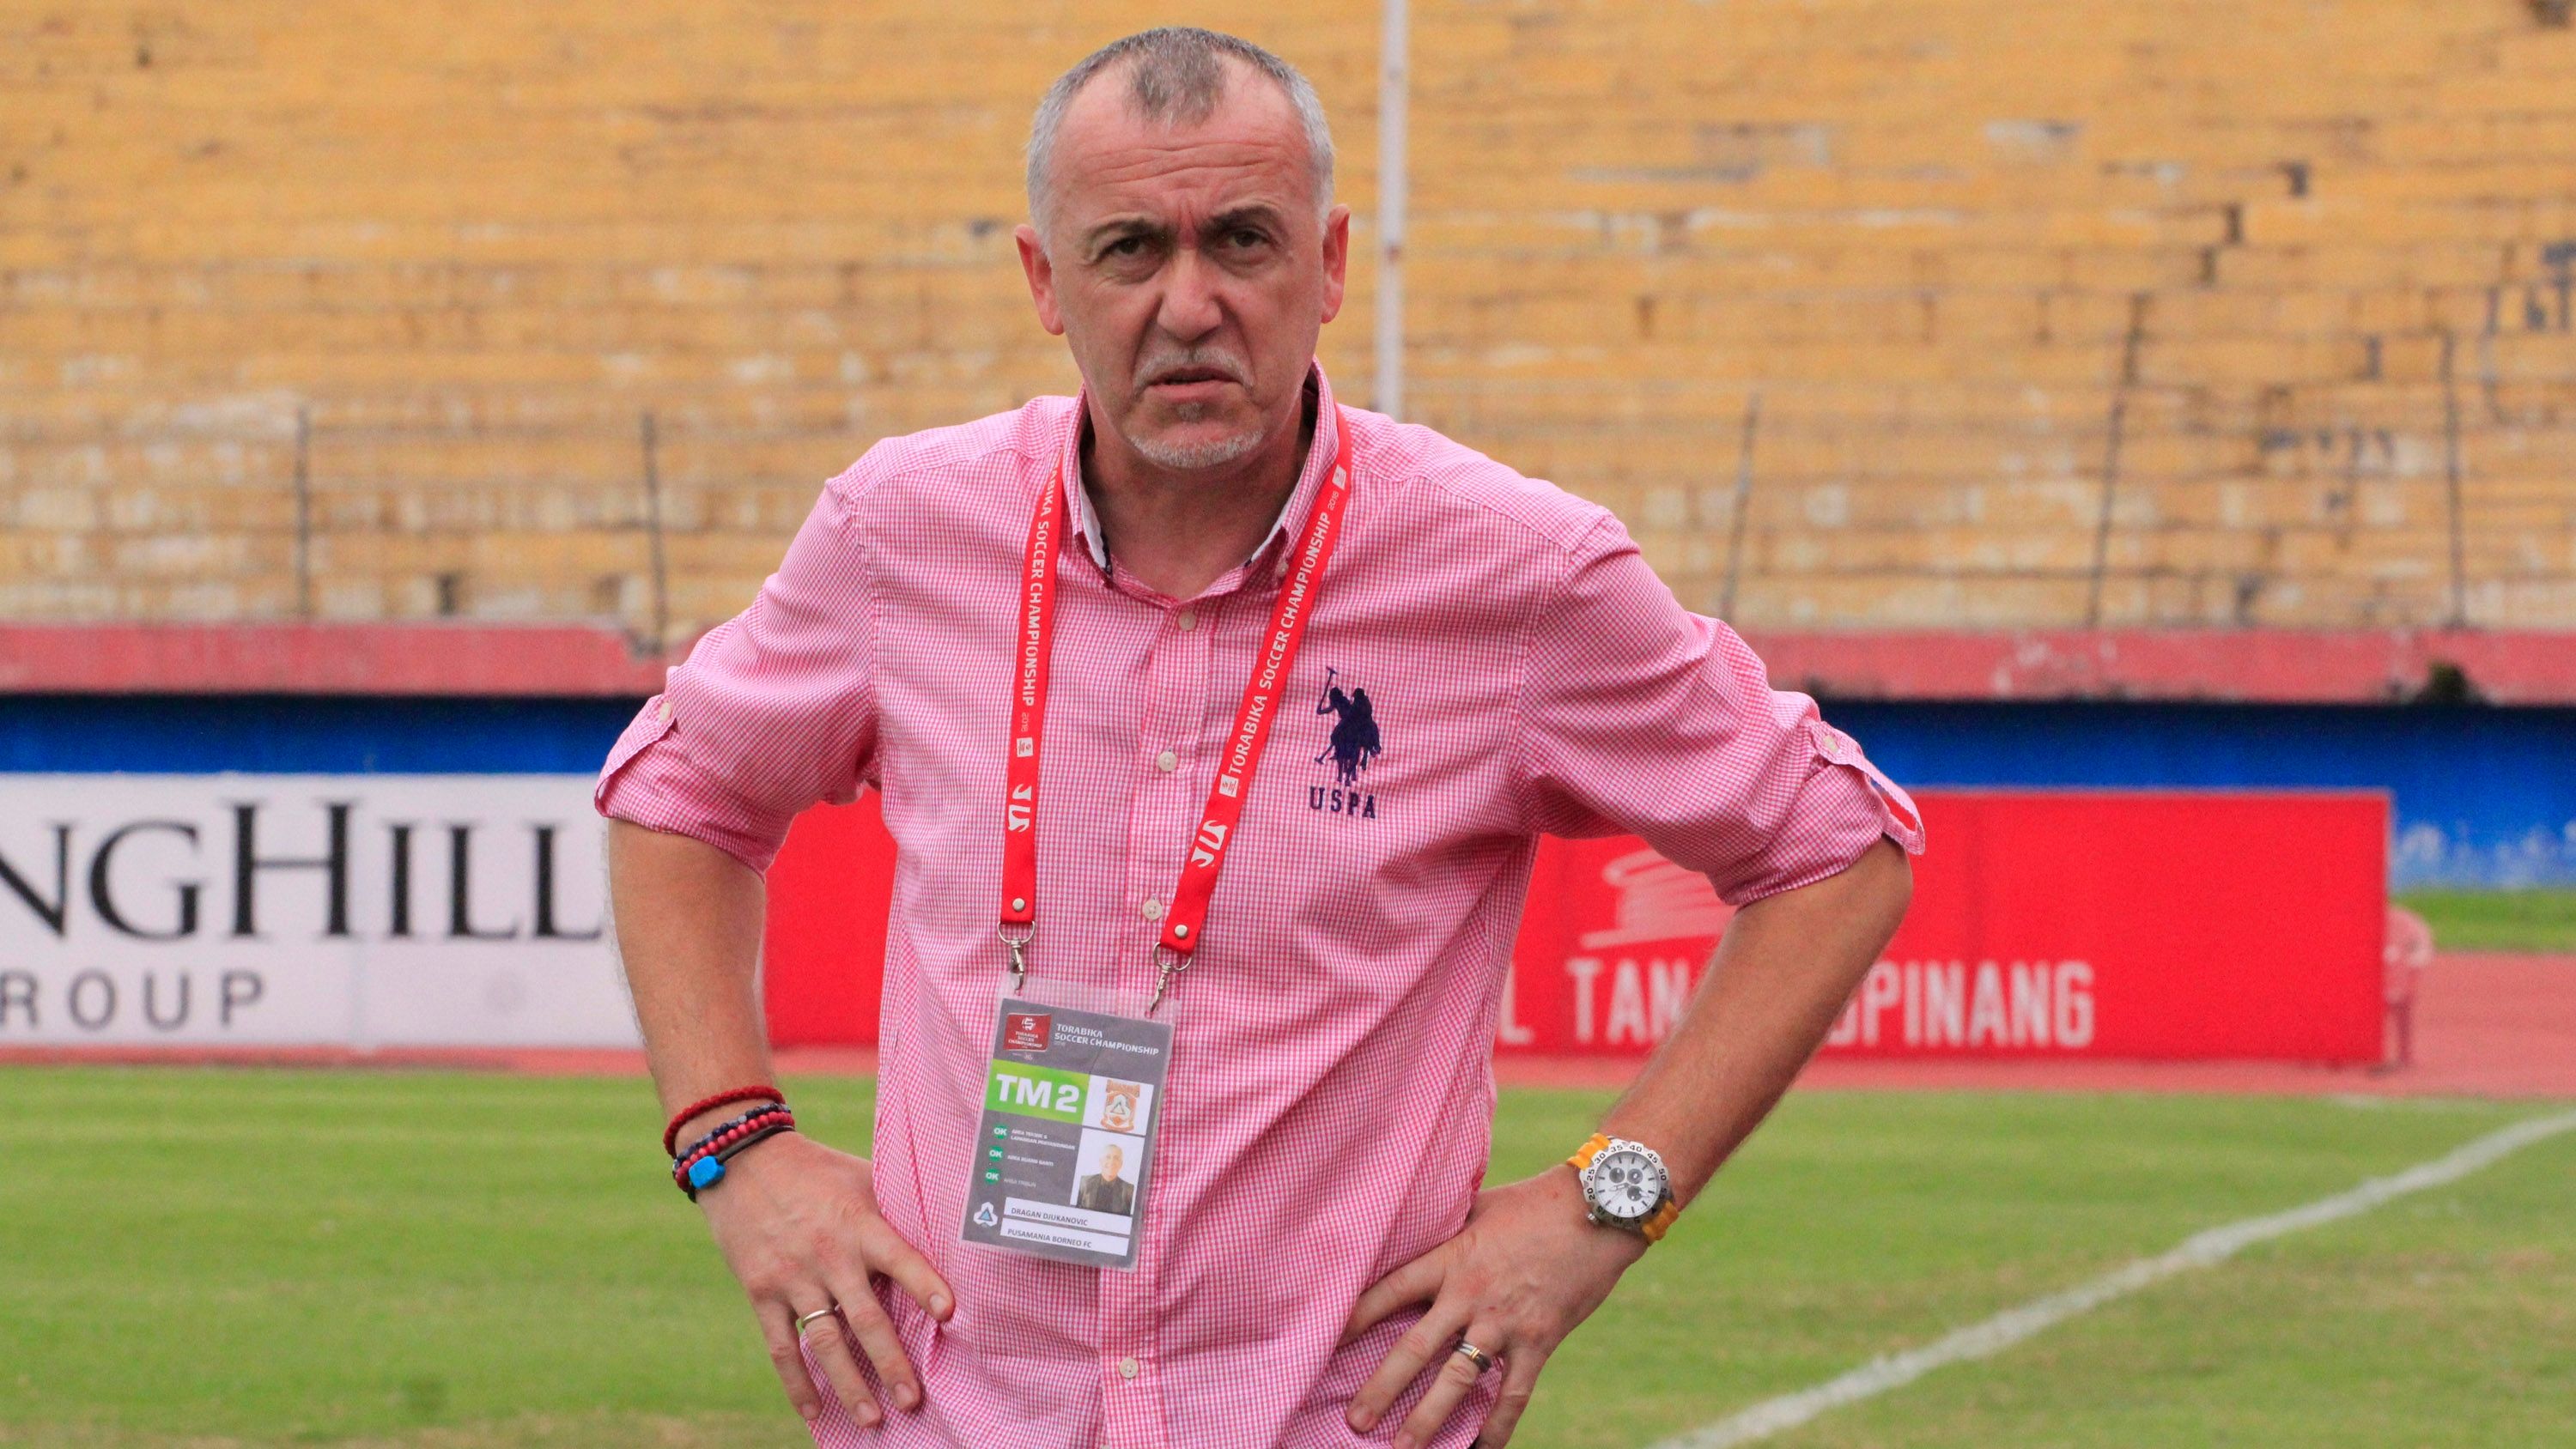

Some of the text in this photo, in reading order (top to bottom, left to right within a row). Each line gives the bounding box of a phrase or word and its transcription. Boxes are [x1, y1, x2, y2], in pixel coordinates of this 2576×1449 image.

[1031, 520, 1049, 579] SOCCER
[1228, 695, 1268, 774] TORABIKA
[1259, 631, 1290, 690] SOCCER
[1280, 512, 1331, 629] CHAMPIONSHIP
[1327, 490, 1340, 511] 2016
[1023, 582, 1043, 706] CHAMPIONSHIP
[1020, 712, 1030, 732] 2016
[1309, 785, 1376, 819] USPA
[1056, 1023, 1103, 1039] TORABIKA
[1054, 1033, 1159, 1055] SOCCER CHAMPIONSHIP
[993, 1127, 1008, 1136] OK
[989, 1149, 1003, 1158] OK
[1610, 1144, 1623, 1153] 35
[1594, 1152, 1606, 1164] 30
[1647, 1153, 1658, 1164] 45
[985, 1172, 999, 1180] OK
[1586, 1168, 1595, 1181] 25
[1658, 1168, 1667, 1181] 50
[1587, 1187, 1595, 1200] 20
[1011, 1207, 1089, 1227] DRAGAN DJUKANOVIC
[1007, 1228, 1051, 1241] PUSAMANIA
[1052, 1236, 1082, 1246] BORNEO
